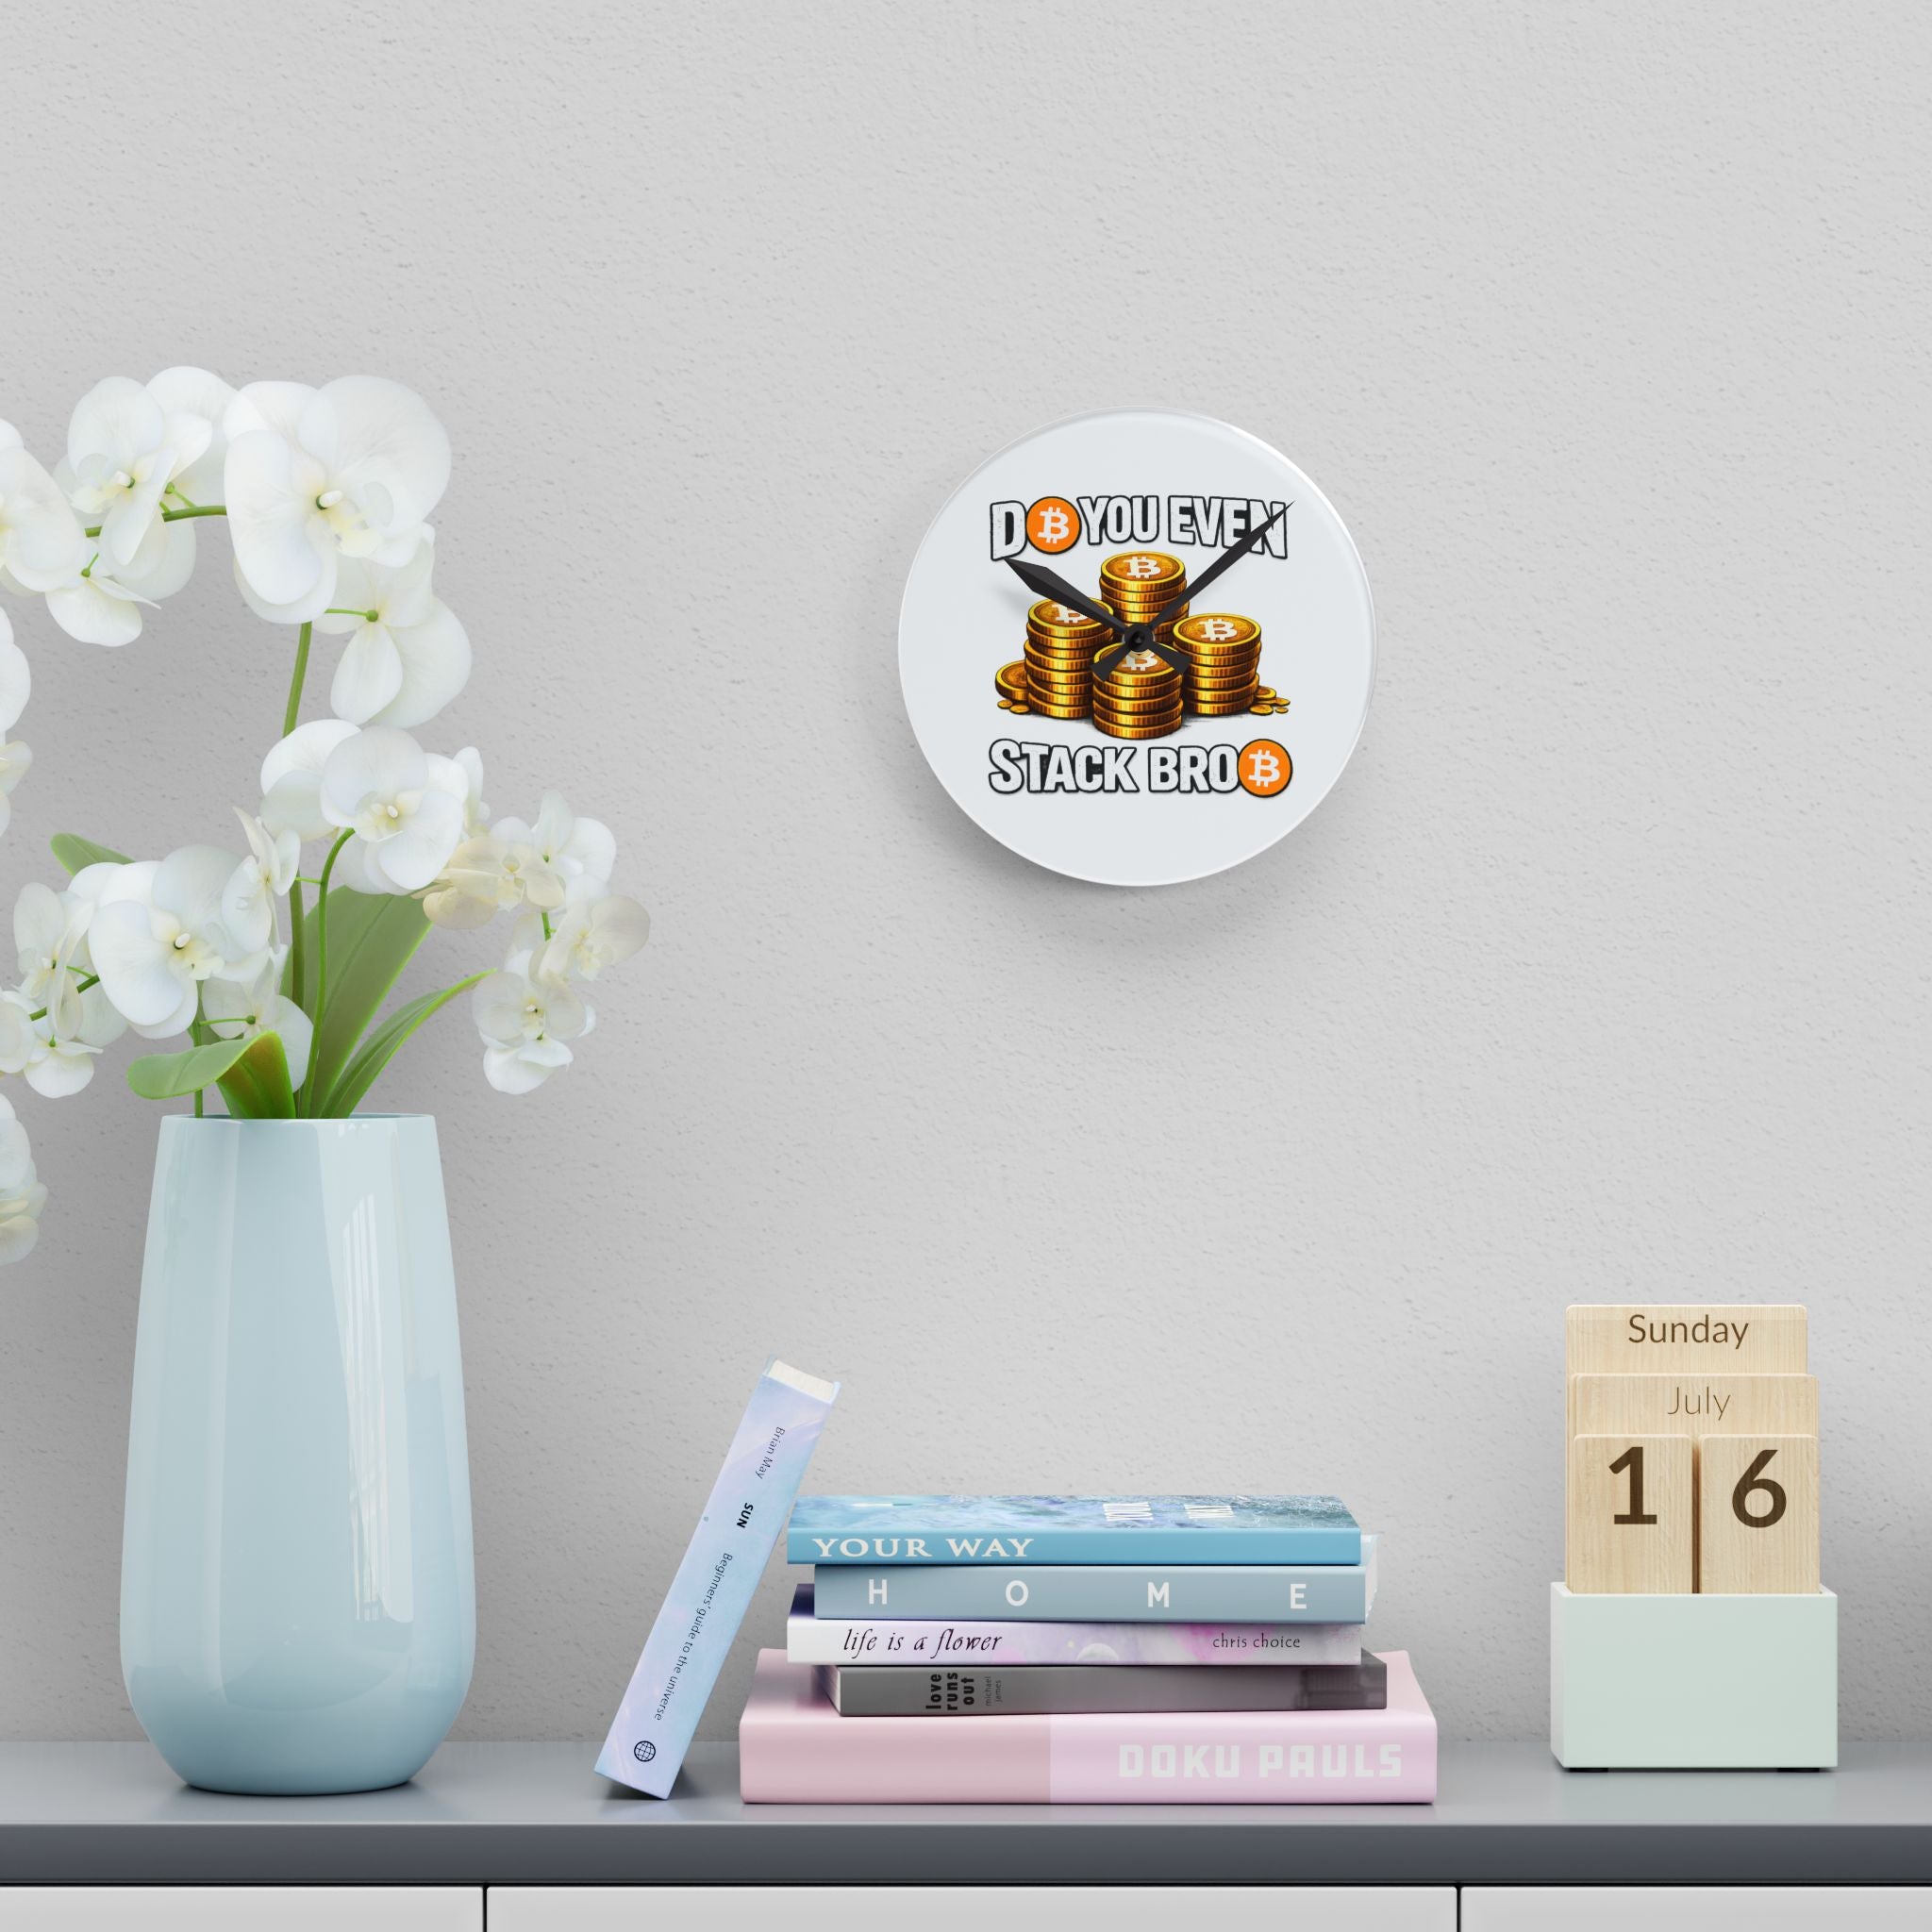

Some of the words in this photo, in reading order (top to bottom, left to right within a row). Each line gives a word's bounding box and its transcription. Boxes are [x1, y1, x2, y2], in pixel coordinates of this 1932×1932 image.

[1076, 495, 1159, 545] YOU
[1167, 495, 1288, 559] EVEN
[989, 739, 1141, 794] STACK
[1628, 1313, 1750, 1350] Sunday
[1667, 1386, 1732, 1422] July
[766, 1426, 786, 1455] Brian
[755, 1456, 774, 1480] May
[1608, 1446, 1657, 1525] 1
[1732, 1449, 1788, 1529] 6
[737, 1502, 754, 1529] SUN
[811, 1538, 934, 1558] YOUR
[944, 1538, 1036, 1557] WAY
[868, 1578, 1307, 1609] HOME
[688, 1607, 707, 1640] guide
[682, 1641, 693, 1653] to
[843, 1628, 878, 1659] life
[887, 1632, 905, 1651] is
[913, 1635, 928, 1651] a
[929, 1628, 1004, 1659] flower
[1212, 1632, 1248, 1649] chris
[1252, 1632, 1302, 1649] choice
[674, 1655, 688, 1674] the
[654, 1675, 678, 1721] universe
[925, 1674, 941, 1709] love
[946, 1672, 958, 1710] runs
[960, 1676, 975, 1706] out
[984, 1675, 992, 1707] michael
[1118, 1743, 1241, 1778] DOKU
[1258, 1743, 1403, 1778] PAULS
